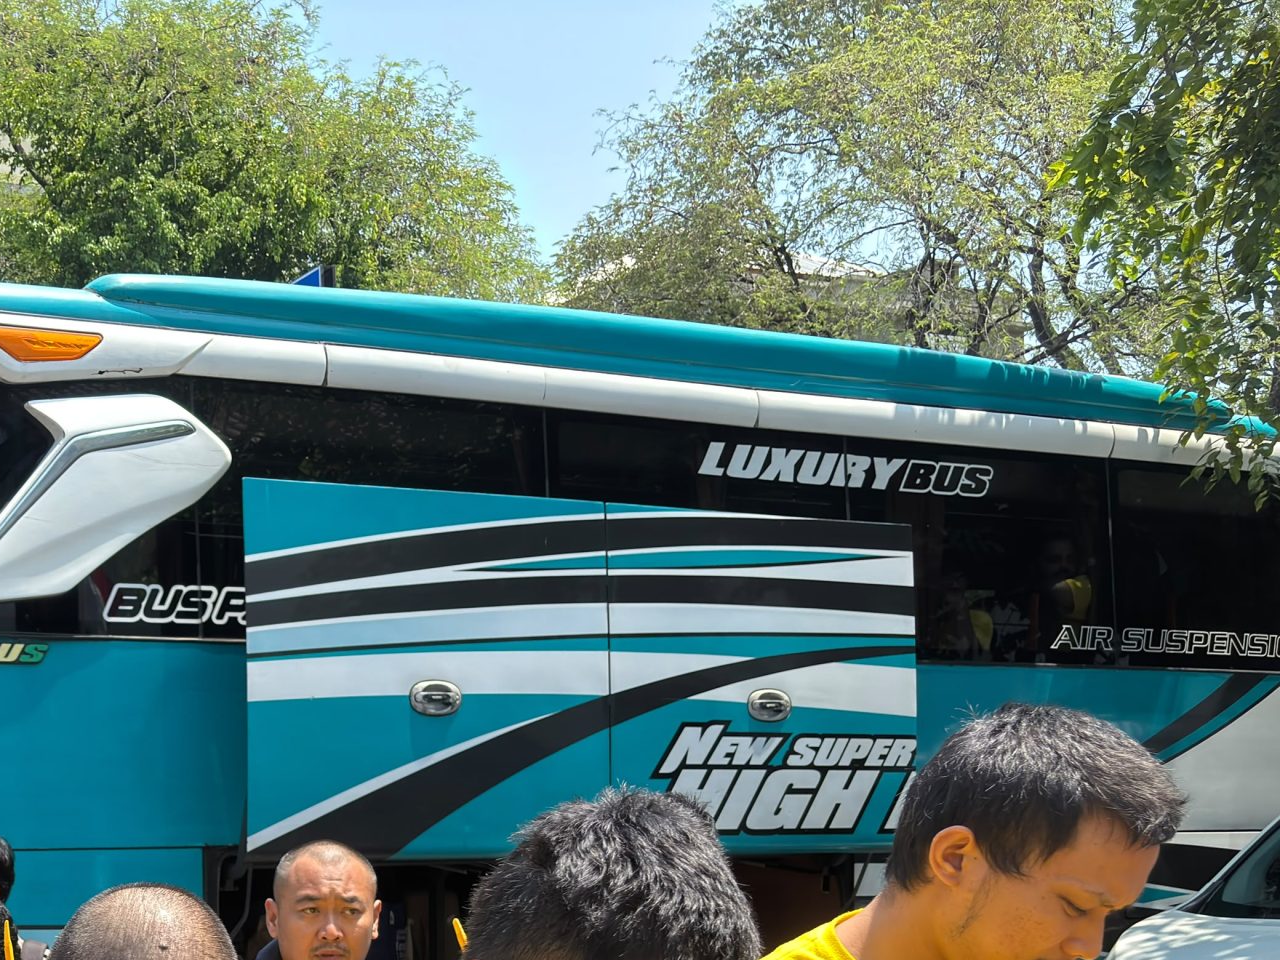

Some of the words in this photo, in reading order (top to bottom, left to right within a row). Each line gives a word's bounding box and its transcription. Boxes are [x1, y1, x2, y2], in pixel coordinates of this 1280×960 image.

[1050, 624, 1114, 651] AIR
[1121, 627, 1280, 658] SUSPENSI
[786, 736, 916, 768] SUPER
